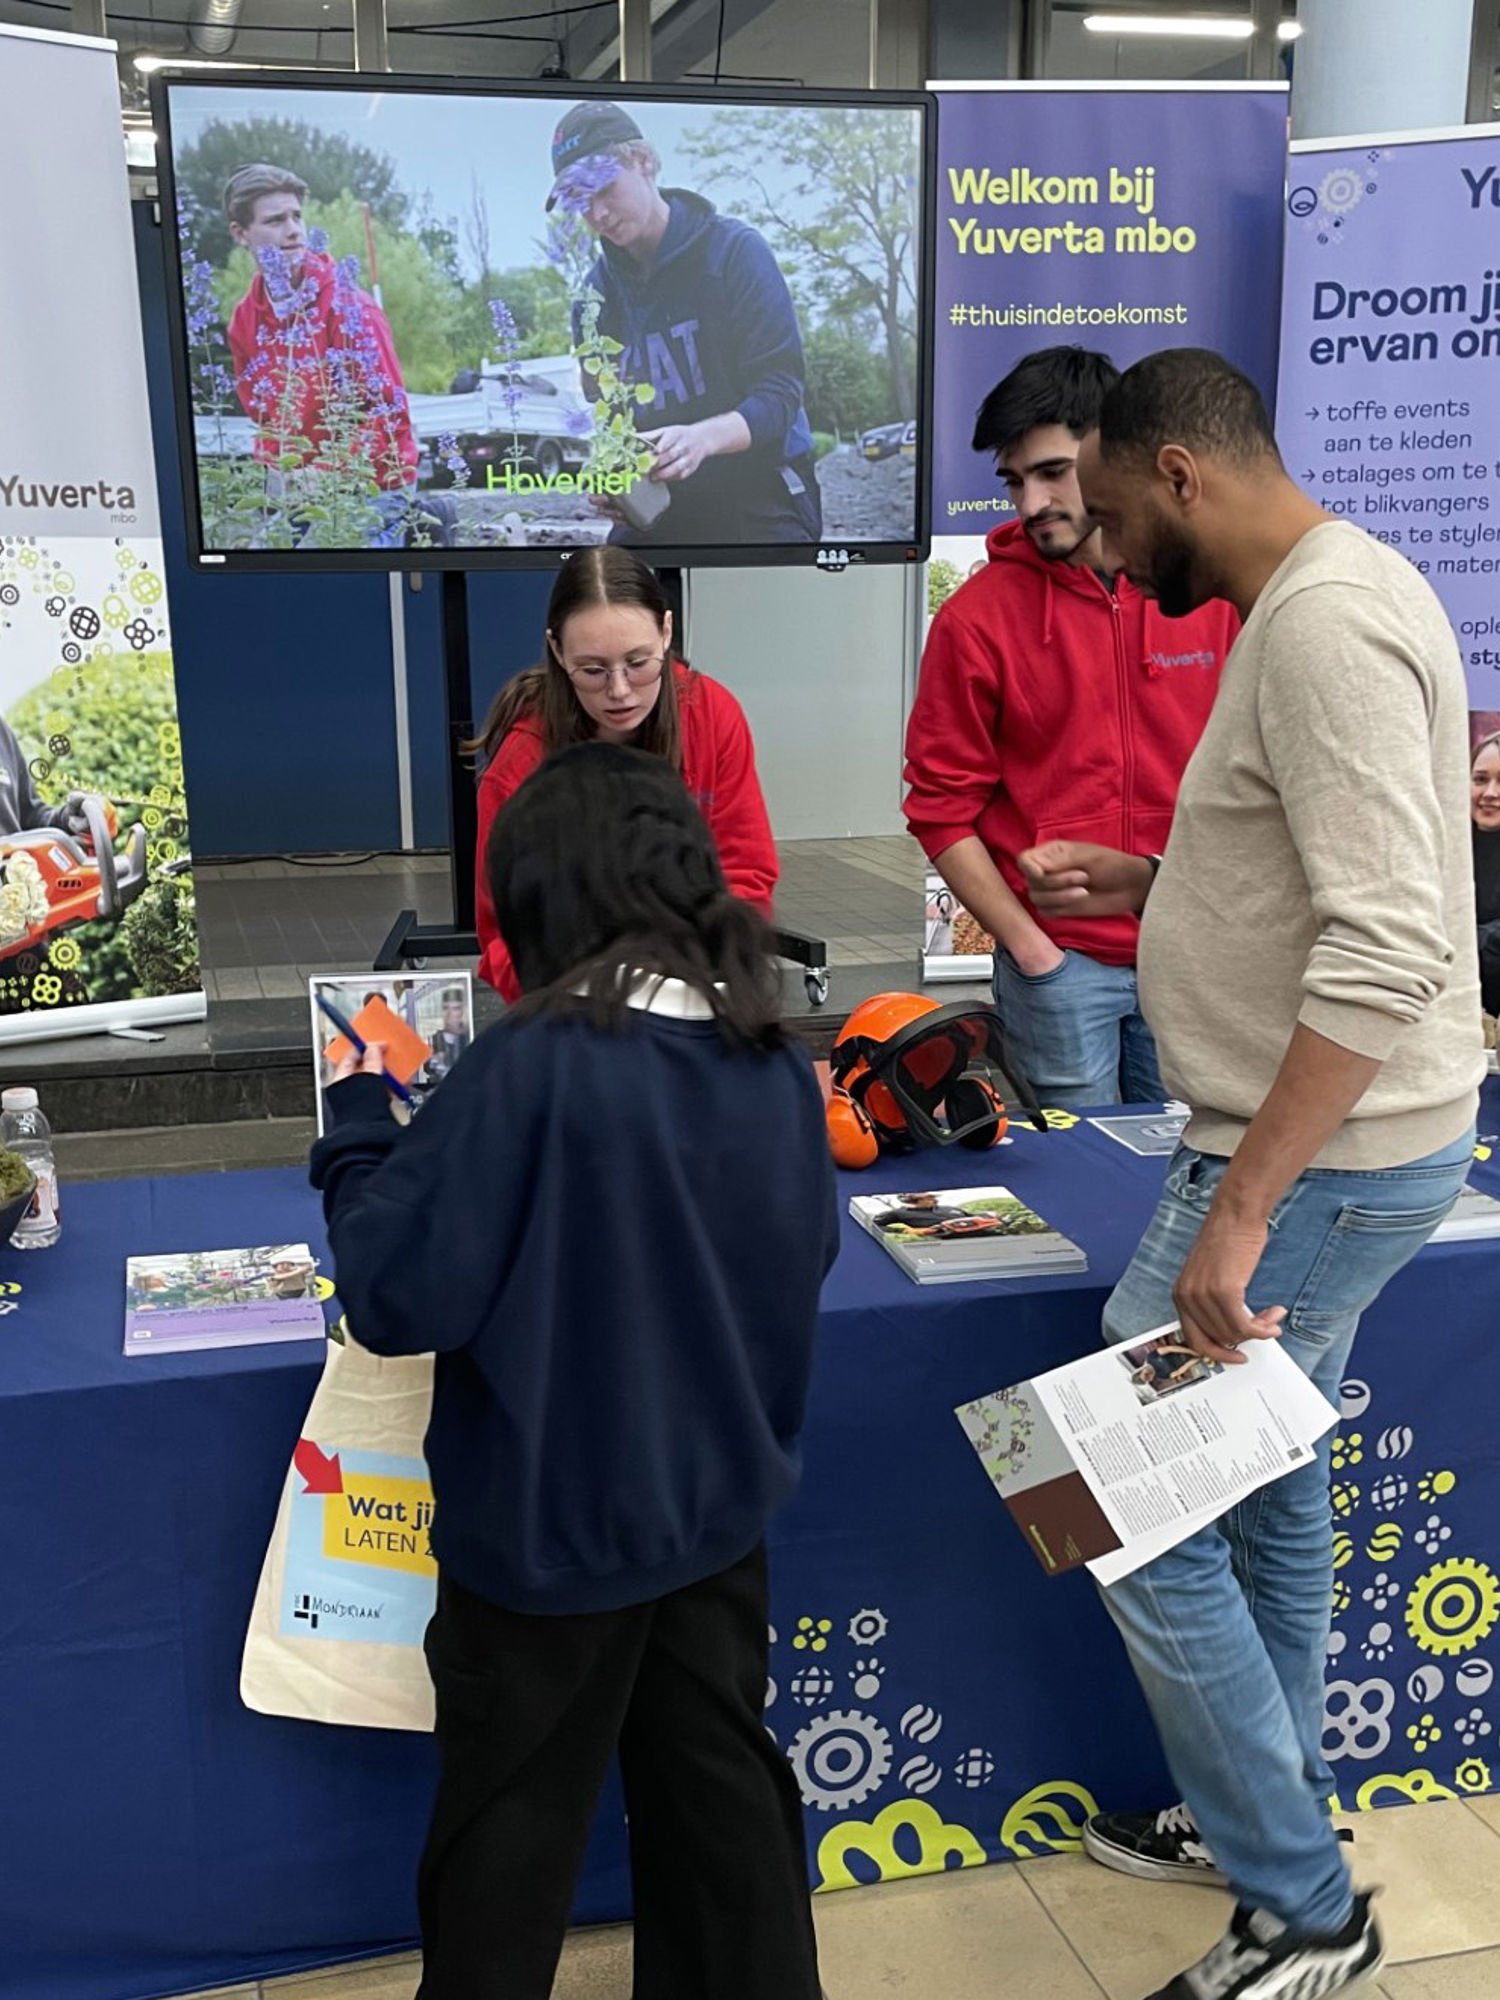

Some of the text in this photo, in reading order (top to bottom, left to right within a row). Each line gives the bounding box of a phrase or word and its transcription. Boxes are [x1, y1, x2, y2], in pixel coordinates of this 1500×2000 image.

[948, 167, 1156, 213] Welkom bij
[948, 217, 1197, 254] Yuverta mbo
[1313, 269, 1500, 324] Droom ji
[949, 303, 1188, 327] #thuisindetoekomst
[1310, 330, 1439, 365] ervan
[1327, 400, 1471, 422] toffe events
[1324, 429, 1472, 453] aan te kleden
[486, 464, 642, 496] Hovenier
[1322, 464, 1415, 488] etalages
[1422, 465, 1455, 481] om
[1463, 462, 1487, 479] te
[0, 475, 136, 510] Yuverta
[110, 512, 137, 524] mbo
[947, 498, 1017, 516] yuverta.
[1321, 494, 1489, 518] tot blikvangers
[1409, 526, 1433, 544] te
[347, 1494, 432, 1531] Wat ji
[344, 1527, 416, 1554] LATEN
[312, 1596, 384, 1619] MONDRIAAN
